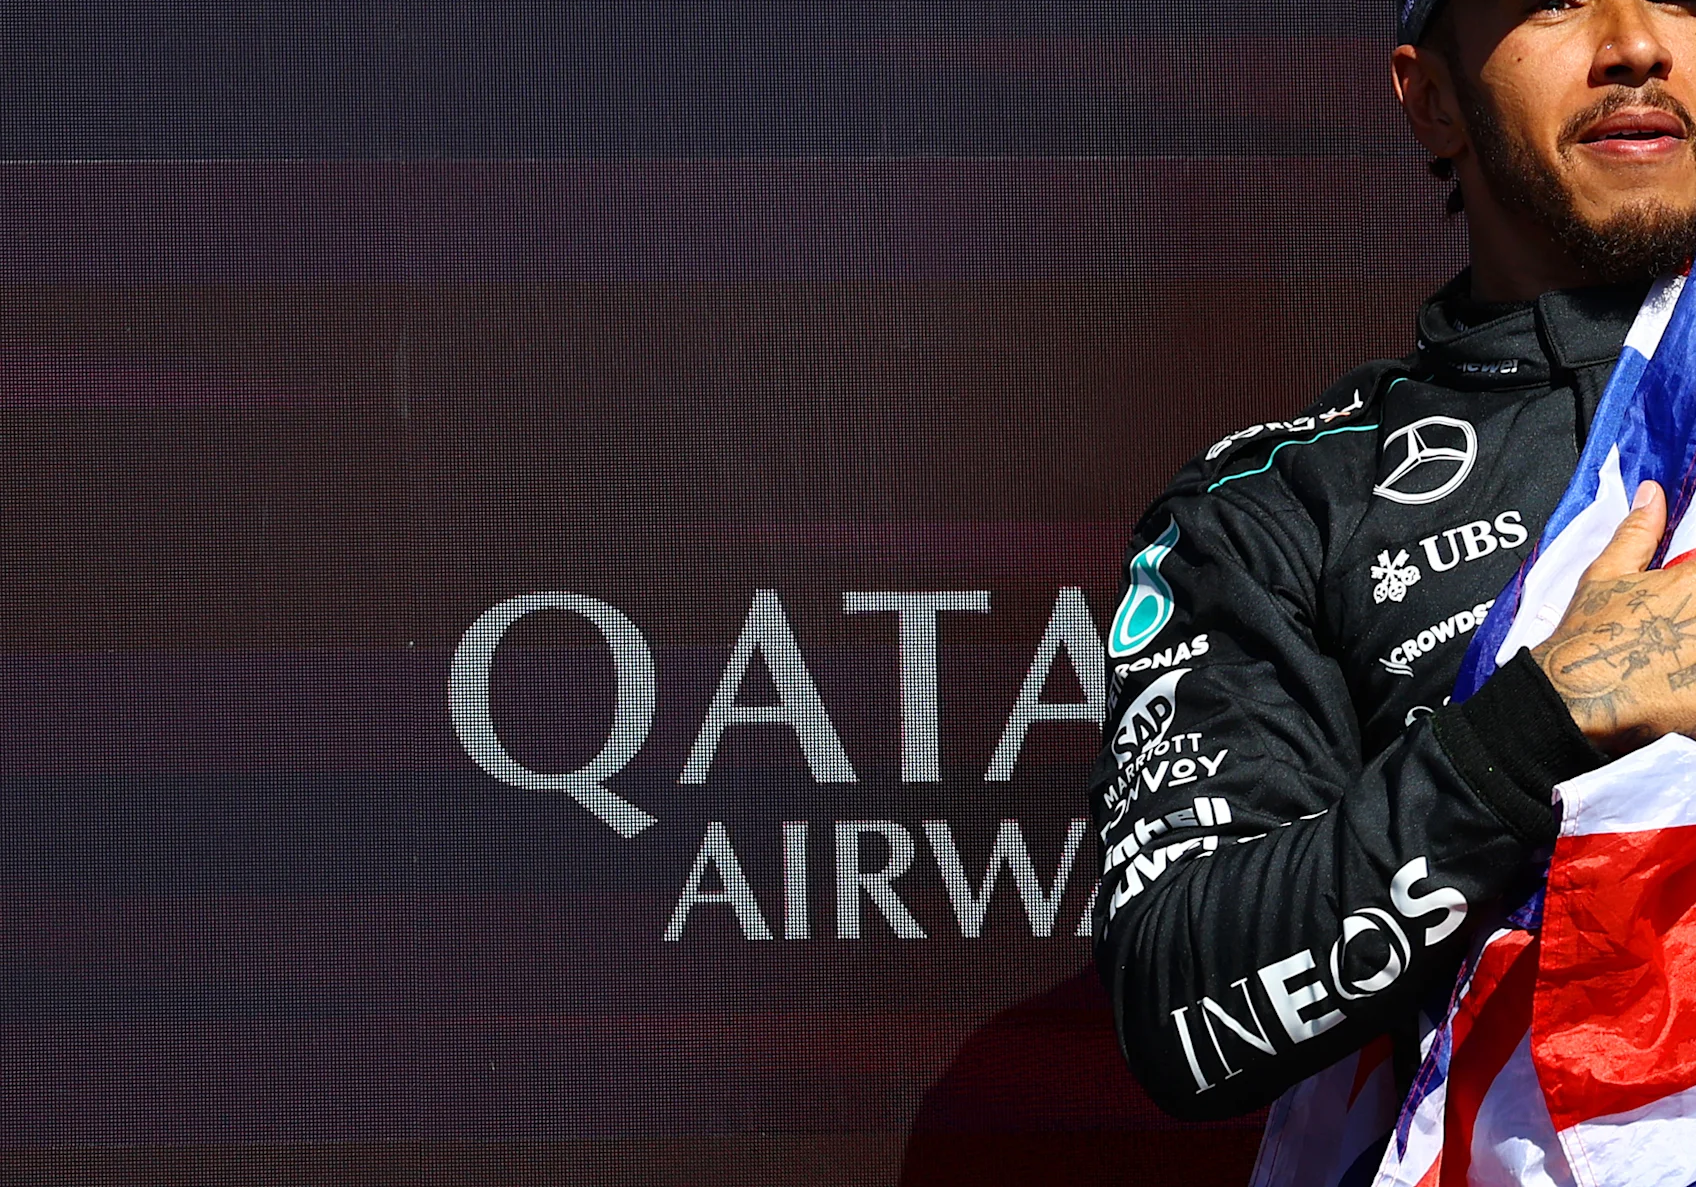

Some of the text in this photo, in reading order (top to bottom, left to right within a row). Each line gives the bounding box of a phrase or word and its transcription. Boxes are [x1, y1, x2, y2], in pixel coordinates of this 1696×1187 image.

[1419, 510, 1528, 573] UBS
[1390, 599, 1495, 666] CROWDS
[448, 587, 1104, 838] QATA
[1108, 633, 1209, 720] ETRONAS
[1100, 749, 1229, 842] ONVOY
[1104, 732, 1202, 809] MARRIOTT
[663, 818, 1099, 941] AIRW
[1104, 796, 1232, 876] inhell
[1171, 856, 1468, 1096] INEOS
